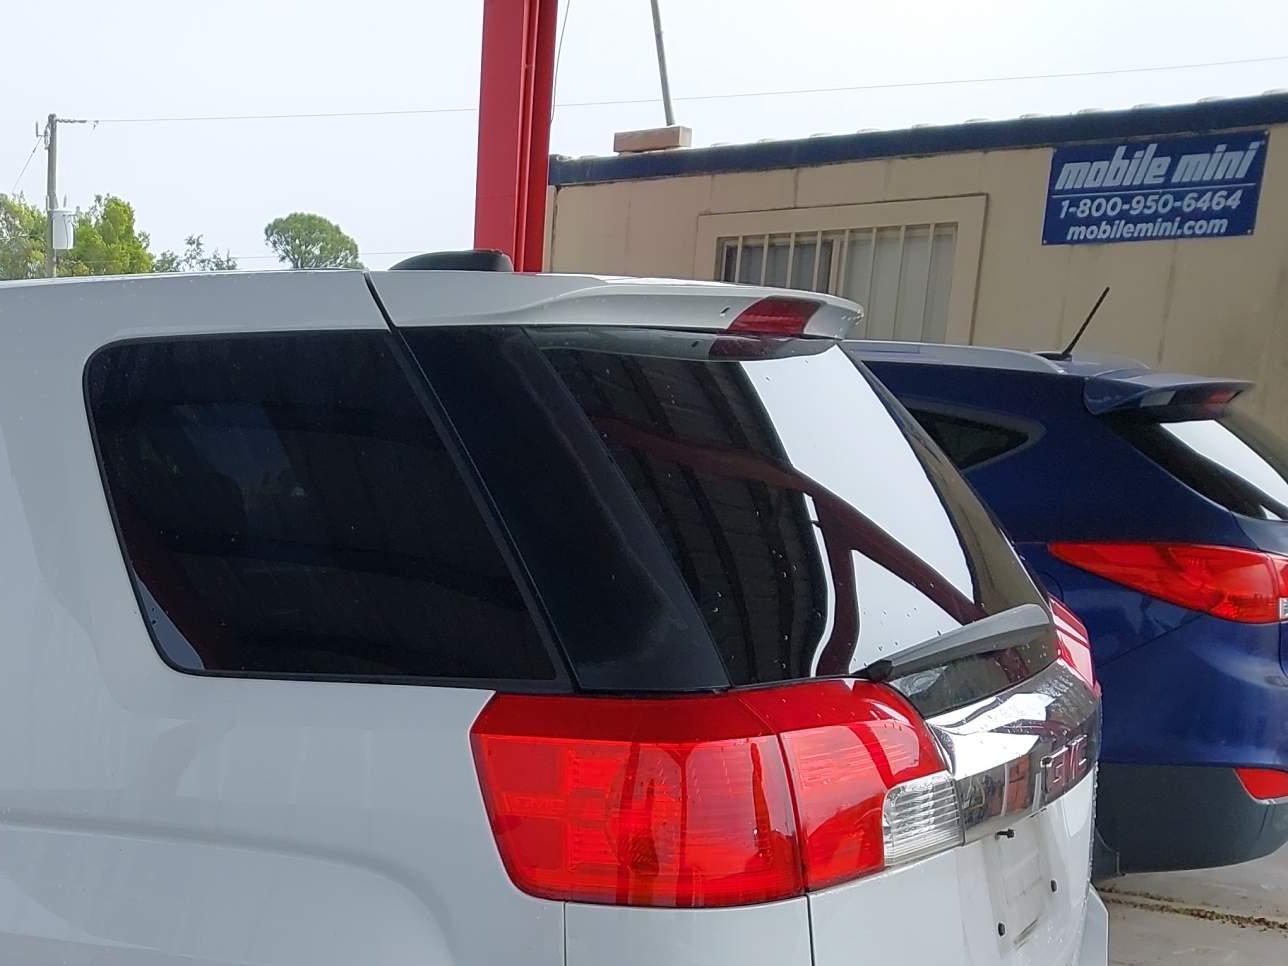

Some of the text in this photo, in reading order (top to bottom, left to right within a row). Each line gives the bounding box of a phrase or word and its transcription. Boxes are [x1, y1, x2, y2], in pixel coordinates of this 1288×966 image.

[1054, 141, 1260, 190] mobile mini
[1059, 188, 1243, 219] 1-800-950-6464
[1066, 217, 1229, 241] mobilemini.com
